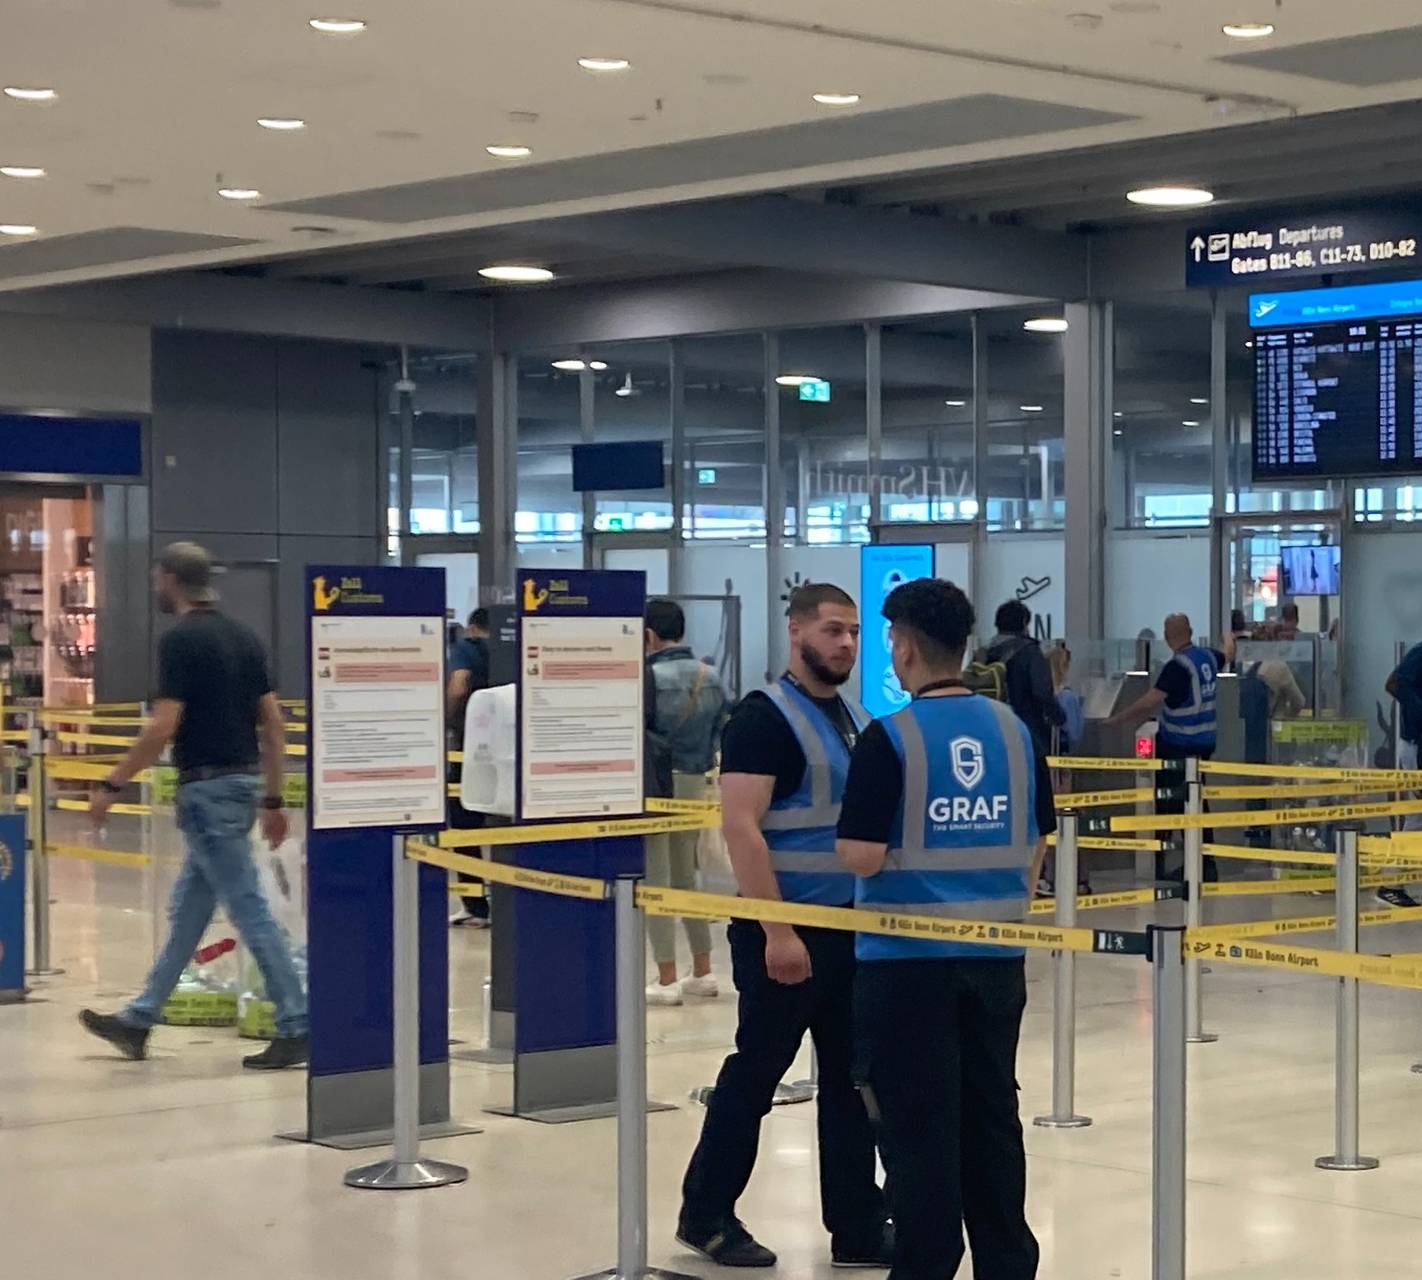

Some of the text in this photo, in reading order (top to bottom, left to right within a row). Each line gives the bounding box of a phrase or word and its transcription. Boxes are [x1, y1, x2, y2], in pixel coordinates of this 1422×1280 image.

[1232, 224, 1344, 250] Abflug Departures
[1231, 256, 1267, 274] Gates
[928, 795, 1008, 822] GRAF
[914, 921, 930, 931] Bonn
[932, 922, 957, 935] Airport
[1019, 930, 1035, 940] Bonn
[1037, 931, 1063, 943] Airport
[1245, 948, 1319, 967] Köln Bonn Airport
